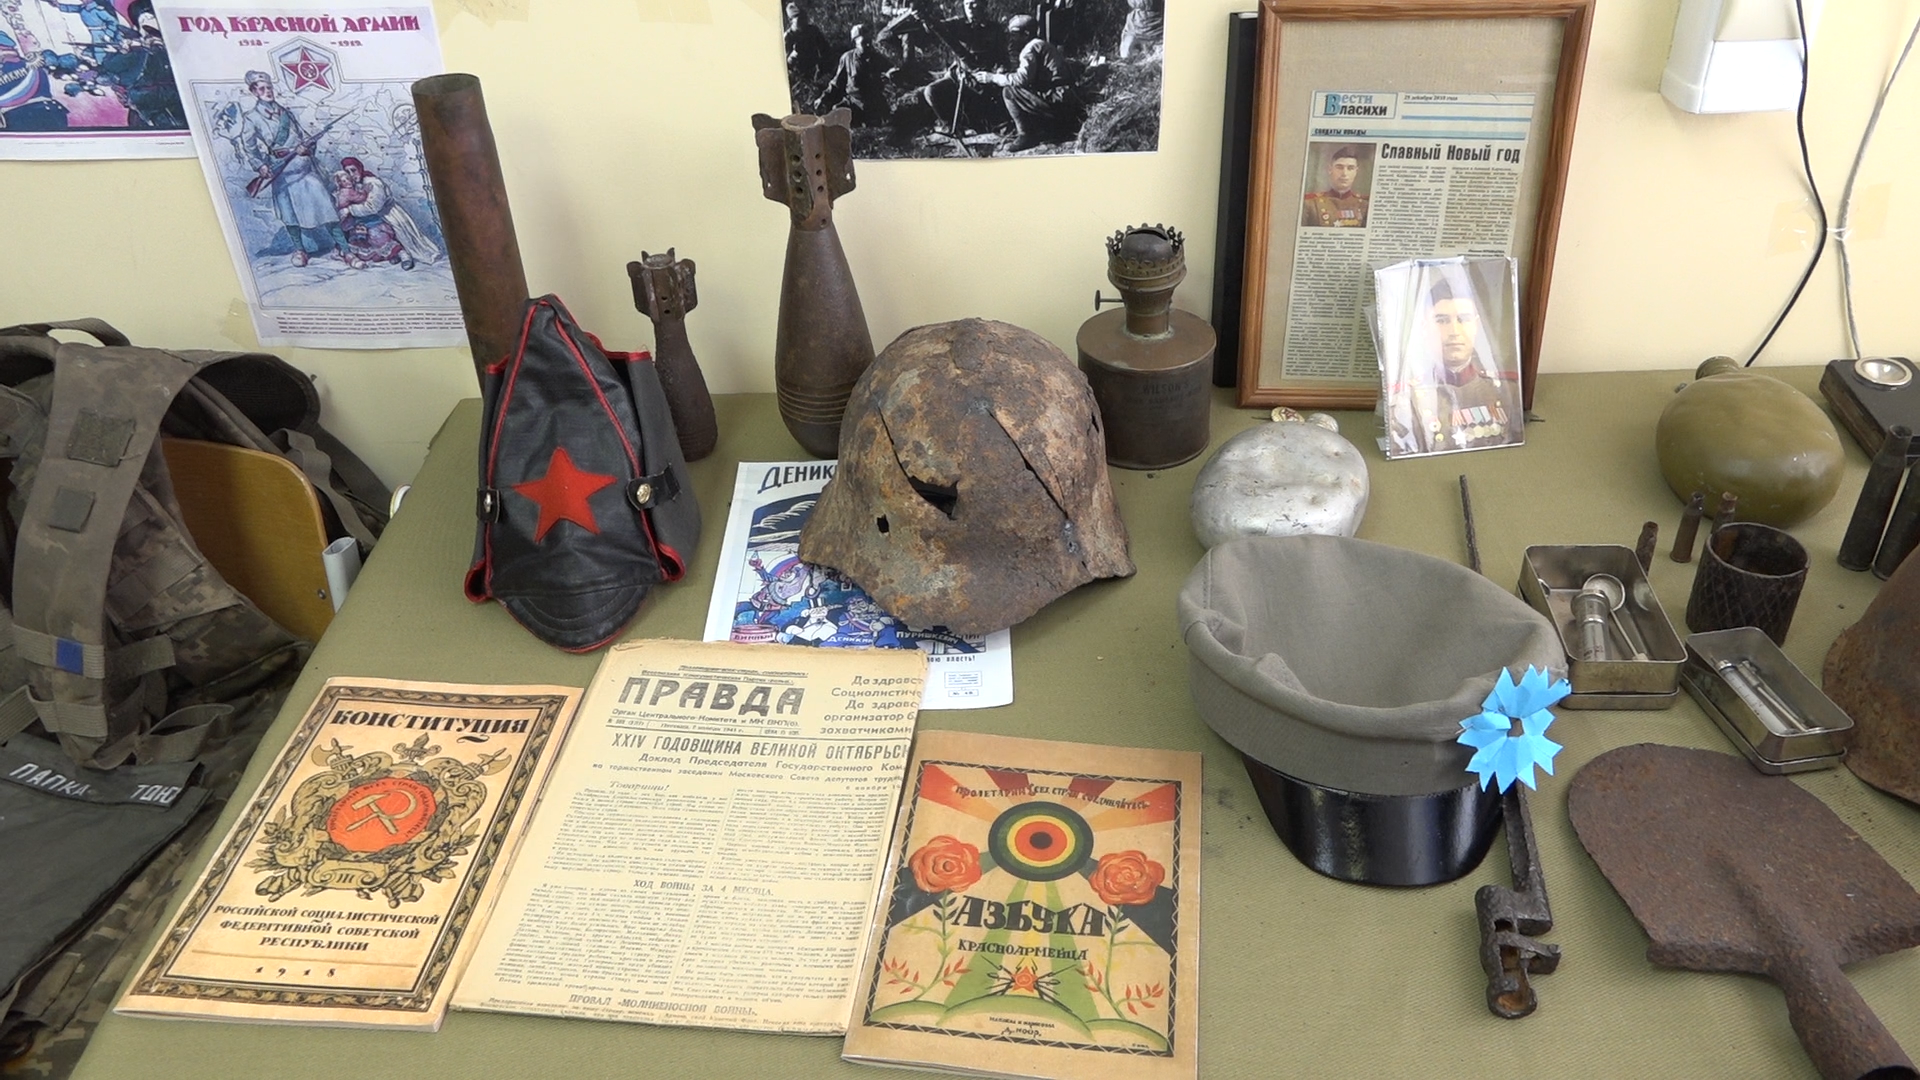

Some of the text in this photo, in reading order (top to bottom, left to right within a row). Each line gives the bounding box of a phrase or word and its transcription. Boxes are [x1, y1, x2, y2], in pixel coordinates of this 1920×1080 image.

[177, 14, 421, 39] ГОД КРАСНОЙ АРМИИ
[1381, 143, 1521, 164] Славный Новый год
[757, 465, 837, 494] ДЕНИК
[851, 676, 870, 686] Да
[618, 677, 805, 717] ПРАВДА
[845, 700, 919, 710] Да здравс
[329, 709, 528, 736] КОНСТИТУЦИЯ
[612, 708, 636, 717] Орган
[698, 714, 737, 724] Комитета
[749, 717, 765, 725] МК
[824, 713, 904, 722] организатор
[820, 726, 912, 735] захватчиками
[612, 733, 647, 748] XXIV
[653, 736, 742, 755] ГОДОВЩИНА
[750, 742, 818, 759] ВЕЛИКОЙ
[638, 753, 906, 773] Доклад Председателя Государственного Ком
[9, 763, 91, 797] ПАПКА
[609, 781, 670, 792] Товарищи!
[633, 880, 654, 889] ХОД
[660, 882, 695, 891] ВОЙНЫ
[701, 885, 714, 893] ЗА
[213, 905, 440, 925] РОССИЙСКОЙ СОЦИАЛИСТИЧЕСКОЙ
[951, 896, 1106, 937] АЗБУКА
[219, 920, 421, 939] ФЕДЕРАТИВНОЙ СОВЕТСКОЙ
[259, 937, 369, 951] РЕСПУБЛИКИ
[958, 939, 1087, 961] КРАСНОАРМЕЙЦА
[569, 994, 612, 1005] ПРОВАЛ
